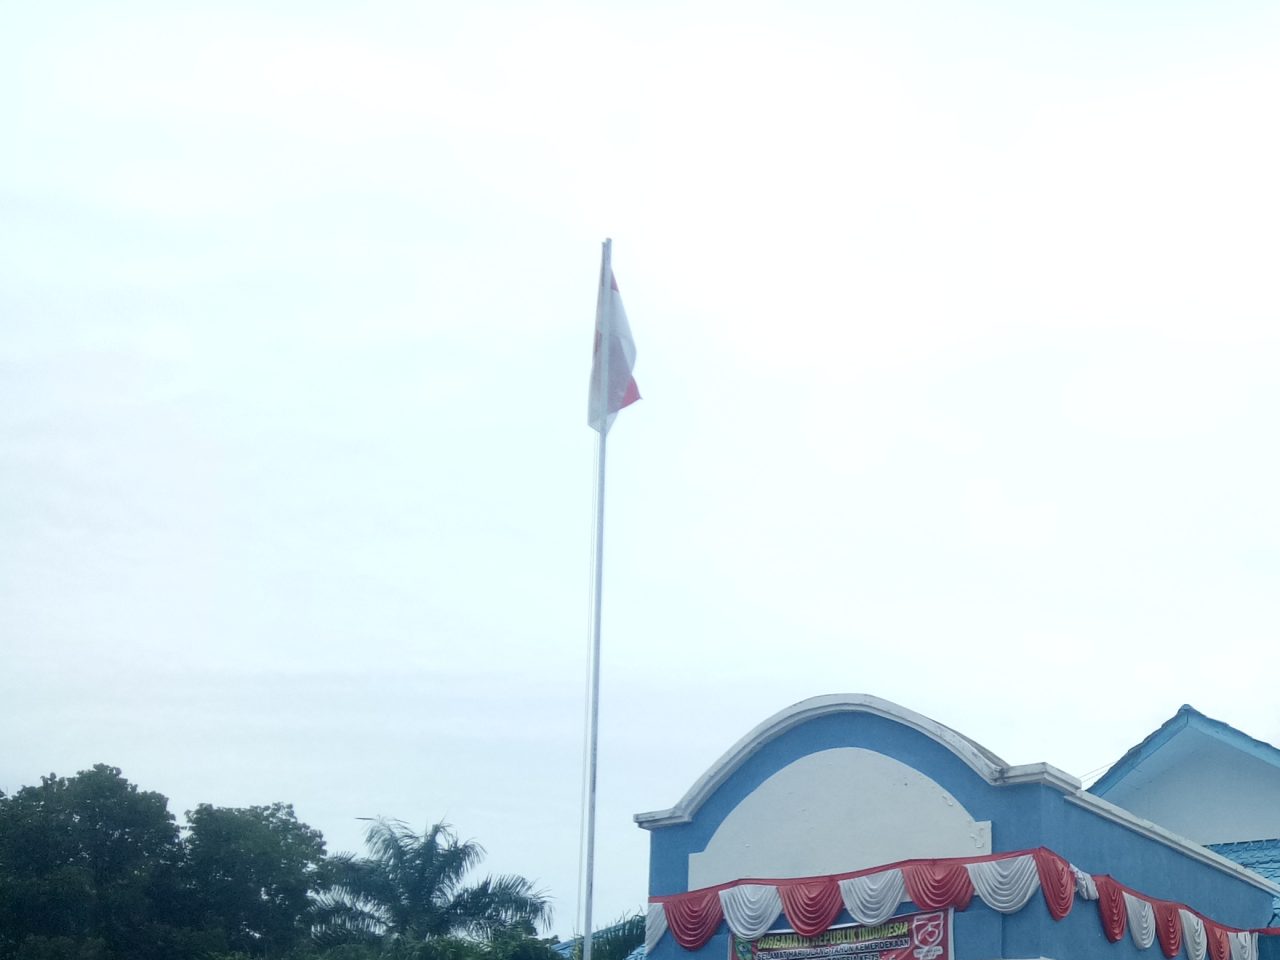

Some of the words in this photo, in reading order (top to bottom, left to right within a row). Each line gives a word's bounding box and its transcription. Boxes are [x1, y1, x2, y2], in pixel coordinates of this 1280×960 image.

[812, 927, 857, 946] REPUBLIK
[858, 921, 909, 941] INDONESIA
[757, 951, 787, 960] SELAMAT
[787, 950, 806, 960] HARI
[806, 948, 830, 959] ULANG
[831, 945, 855, 956] TAHUN
[855, 938, 909, 953] KEMERDEKAAN
